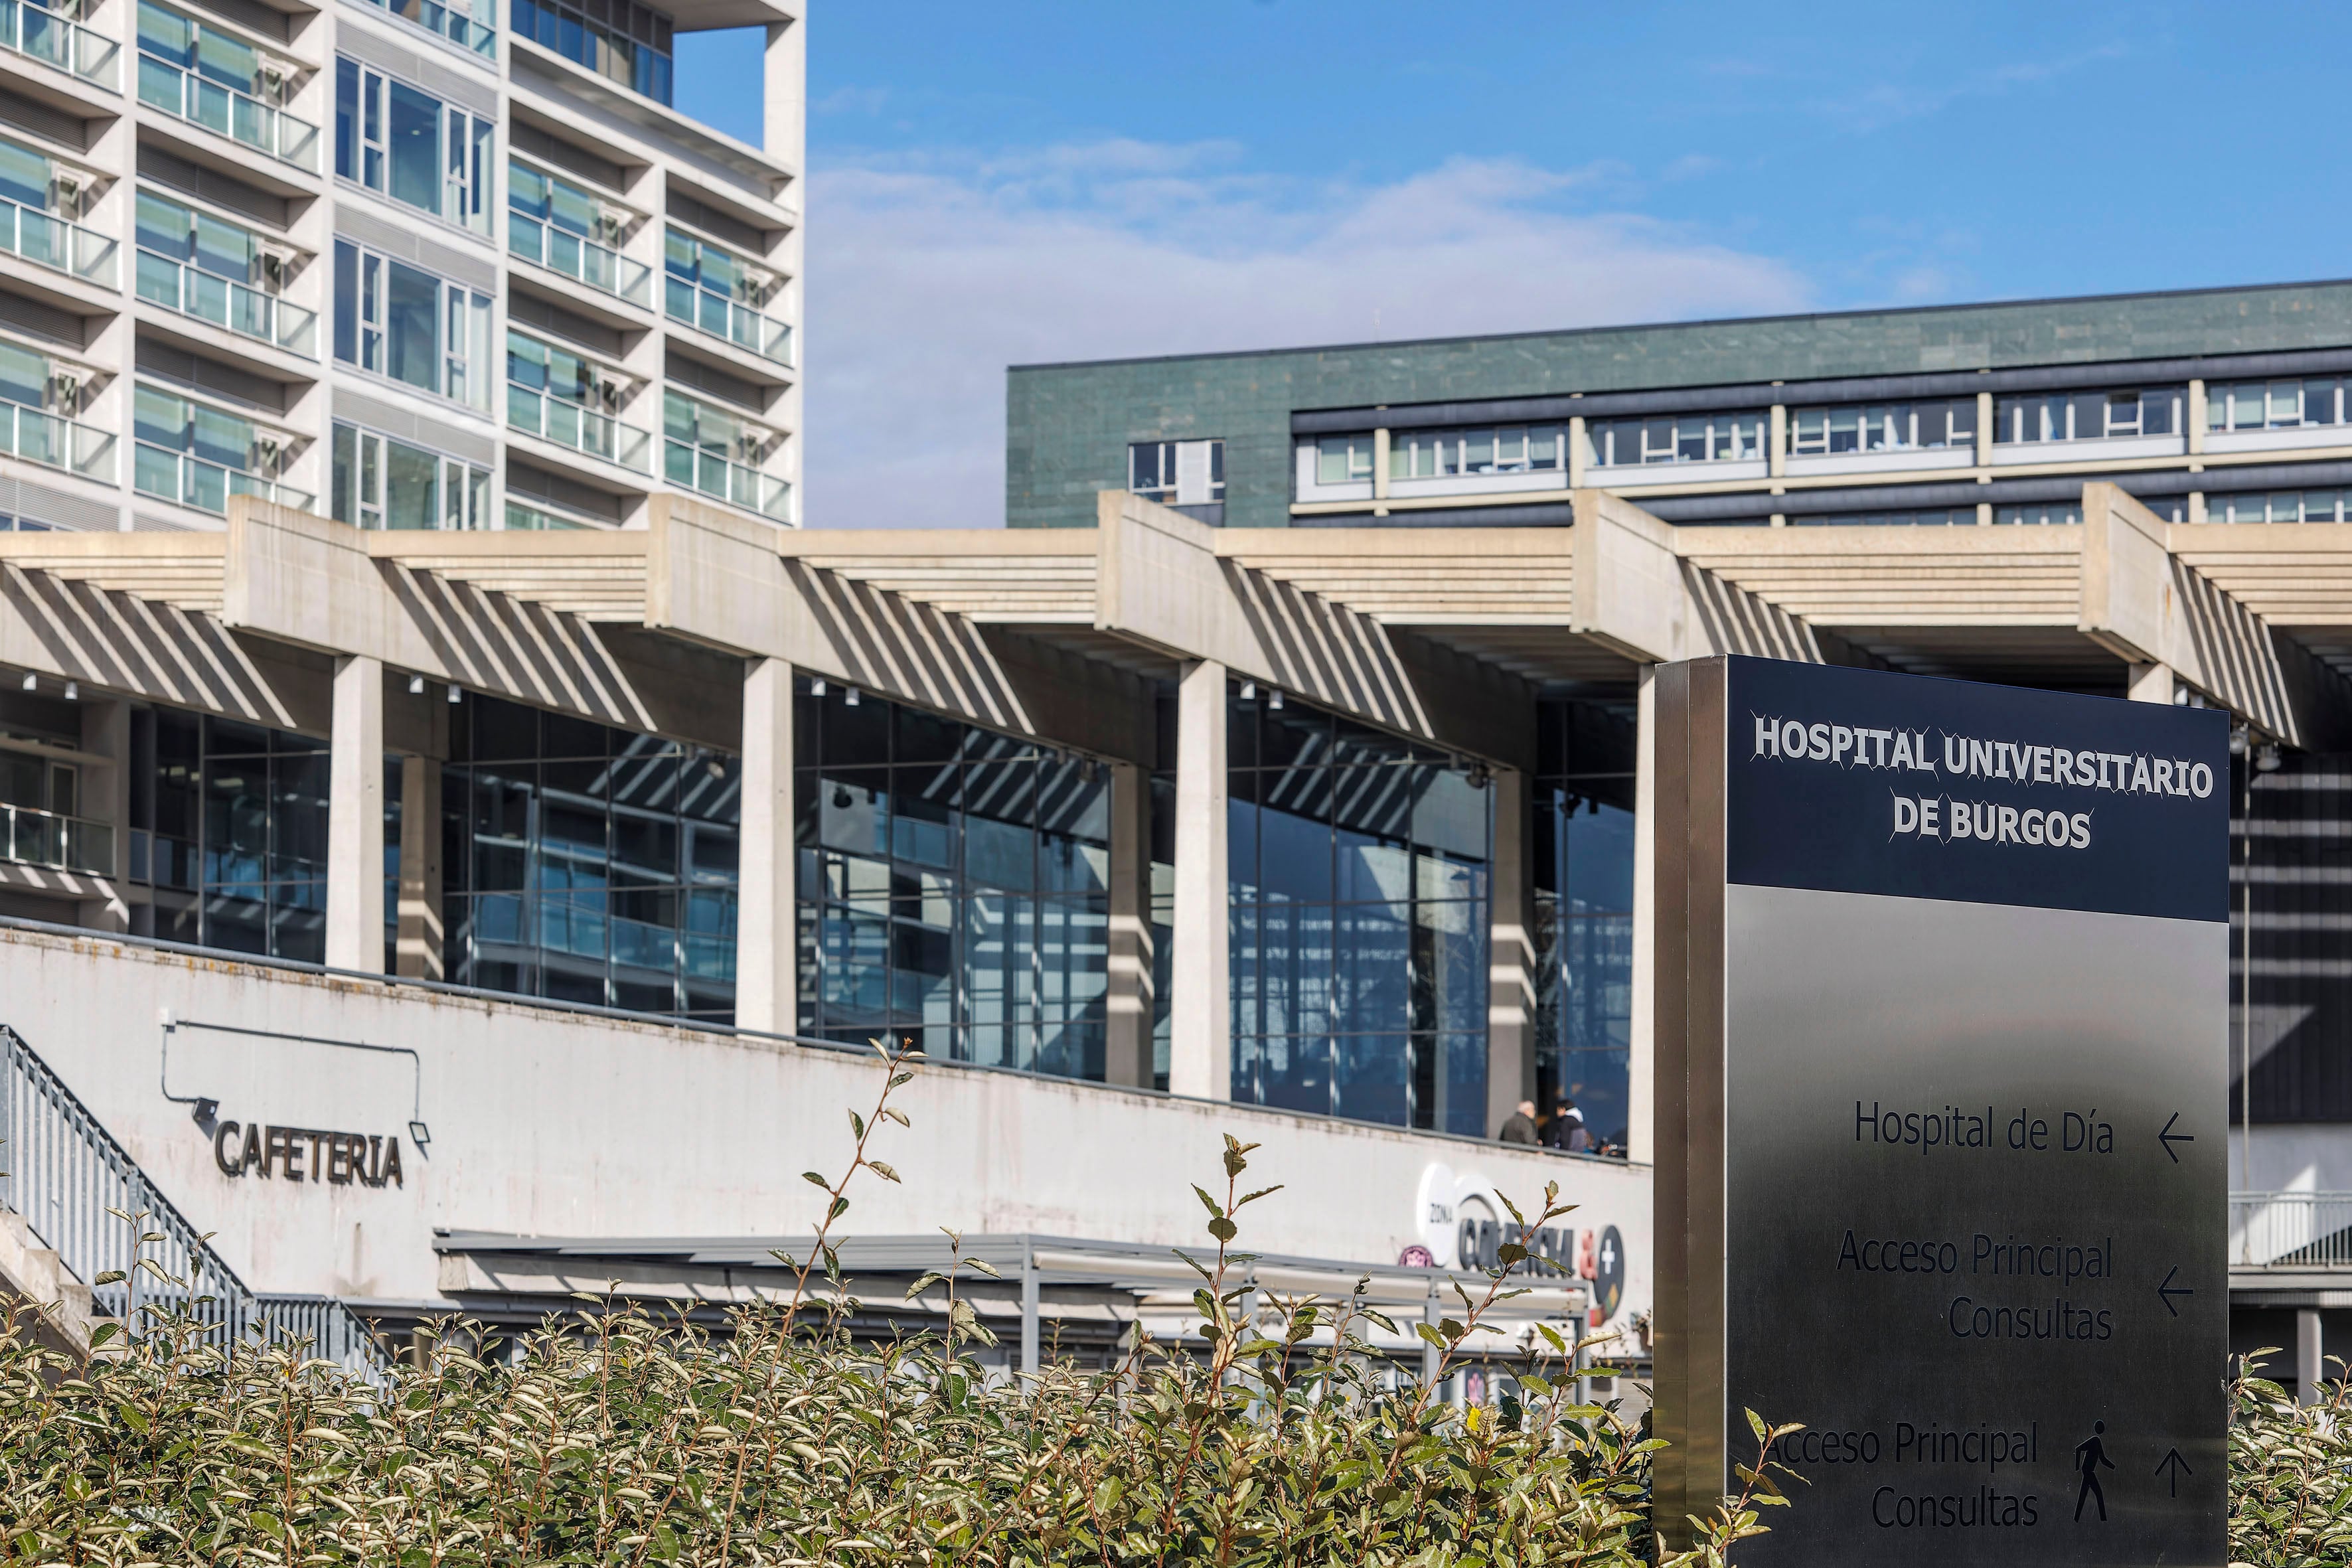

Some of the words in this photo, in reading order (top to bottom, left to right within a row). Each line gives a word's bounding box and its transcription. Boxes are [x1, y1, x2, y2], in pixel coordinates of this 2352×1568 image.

[1755, 717, 1937, 771] HOSPITAL
[1945, 736, 2213, 798] UNIVERSITARIO
[1894, 796, 1940, 835] DE
[1950, 801, 2091, 849] BURGOS
[215, 1120, 403, 1189] CAFETERIA
[1856, 1101, 1992, 1156] Hospital
[2008, 1108, 2048, 1150] de
[2063, 1109, 2114, 1154] Día
[1837, 1229, 1957, 1273] Acceso
[1972, 1233, 2111, 1286] Principal
[1949, 1296, 2112, 1340] Consultas
[1895, 1422, 2037, 1472] Principal
[1872, 1484, 2038, 1528] Consultas
